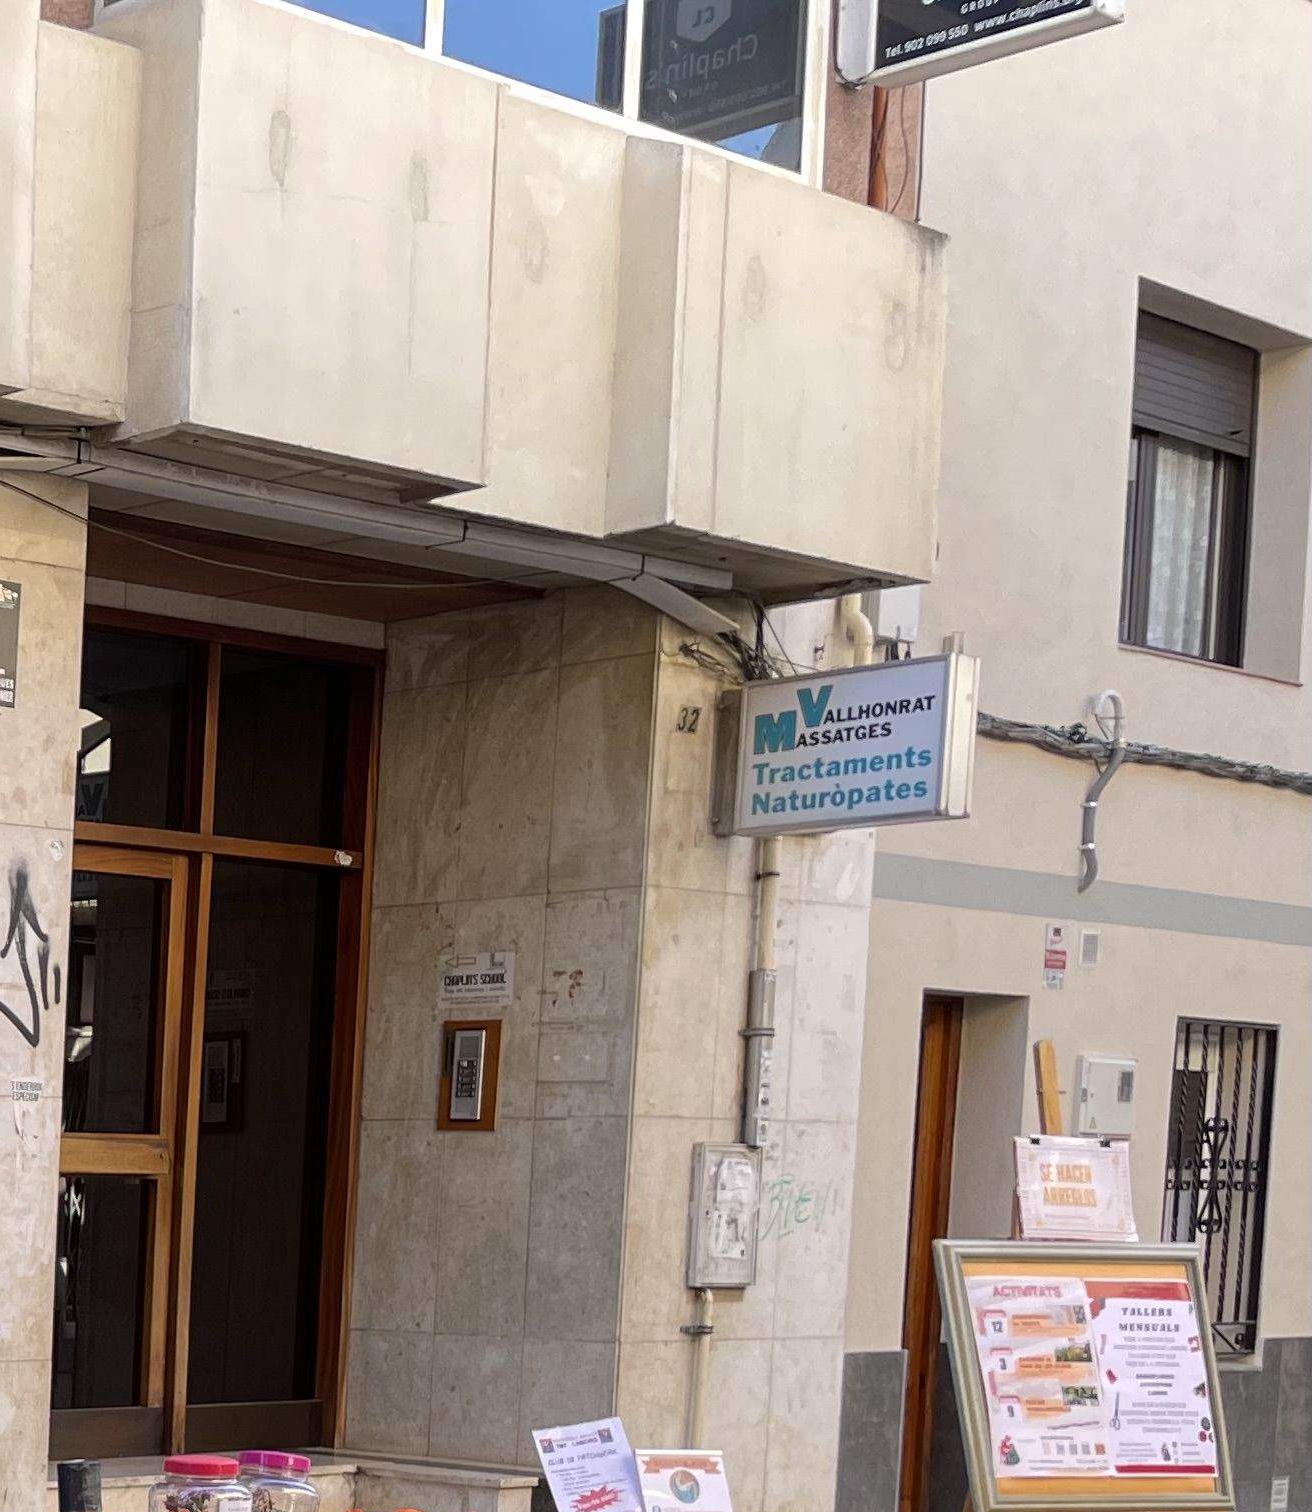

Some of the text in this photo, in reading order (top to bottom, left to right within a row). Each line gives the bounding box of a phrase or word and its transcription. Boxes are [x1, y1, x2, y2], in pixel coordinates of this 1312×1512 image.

[797, 684, 936, 728] VALLHONRAT
[753, 711, 892, 755] MASSATGES
[753, 747, 932, 785] Tractaments
[751, 780, 929, 816] Naturòpates
[1119, 1323, 1181, 1332] MENSUALS
[1121, 1307, 1173, 1317] TALLERS
